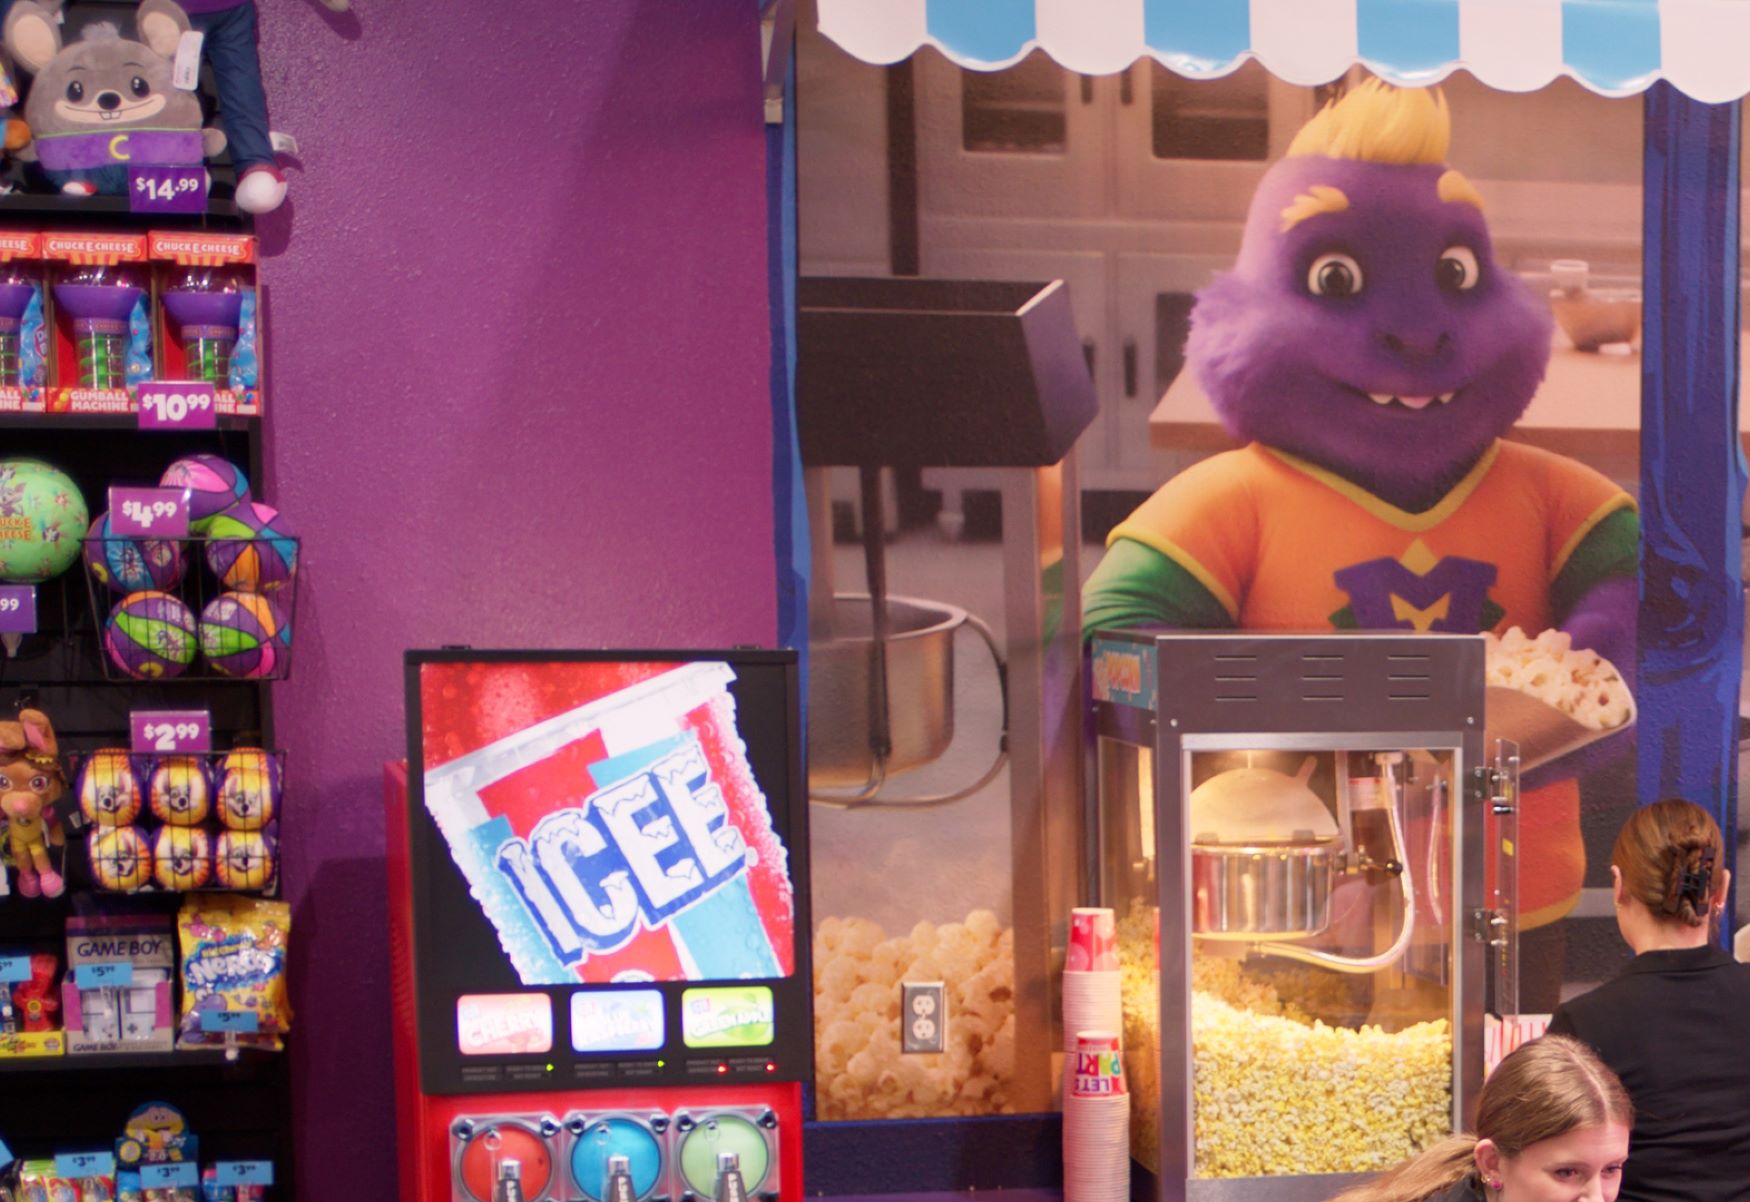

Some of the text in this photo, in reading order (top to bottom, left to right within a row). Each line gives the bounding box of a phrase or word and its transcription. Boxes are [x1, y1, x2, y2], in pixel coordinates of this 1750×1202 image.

[136, 177, 199, 200] $14.99
[49, 240, 135, 254] CHUCK E CHEESE
[156, 241, 240, 255] CHUCK E CHEESE
[70, 391, 128, 402] GUMBALL
[72, 401, 129, 412] MACHINE
[495, 742, 750, 966] ICEE
[77, 940, 161, 957] GAME BOY
